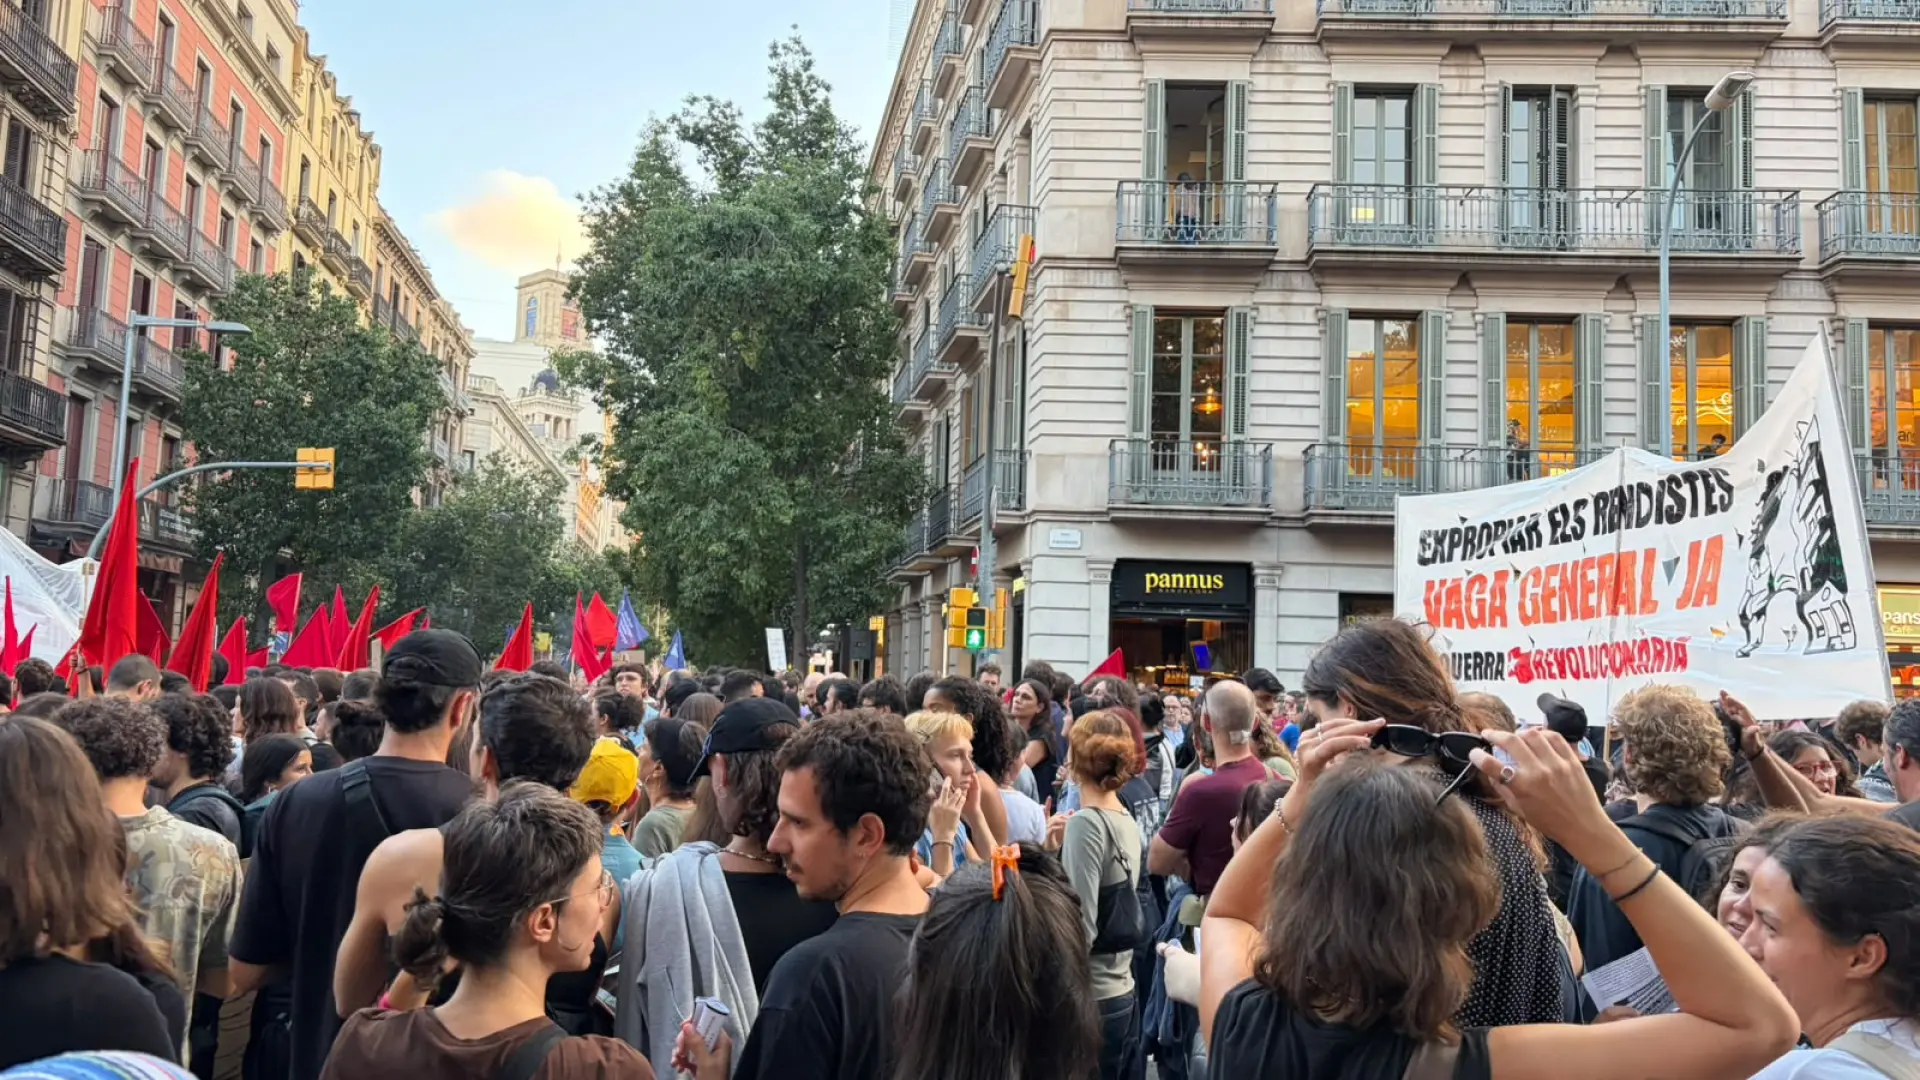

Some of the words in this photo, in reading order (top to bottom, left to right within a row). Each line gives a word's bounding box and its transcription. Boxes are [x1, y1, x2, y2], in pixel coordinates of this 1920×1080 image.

[1417, 513, 1542, 566] EXPROPIAR
[1548, 498, 1588, 545] ELS
[1593, 468, 1734, 536] RENDISTES
[1145, 571, 1224, 594] pannus
[1423, 570, 1509, 630] VAGA
[1518, 548, 1659, 627] GENERAL
[1676, 534, 1723, 610] JA
